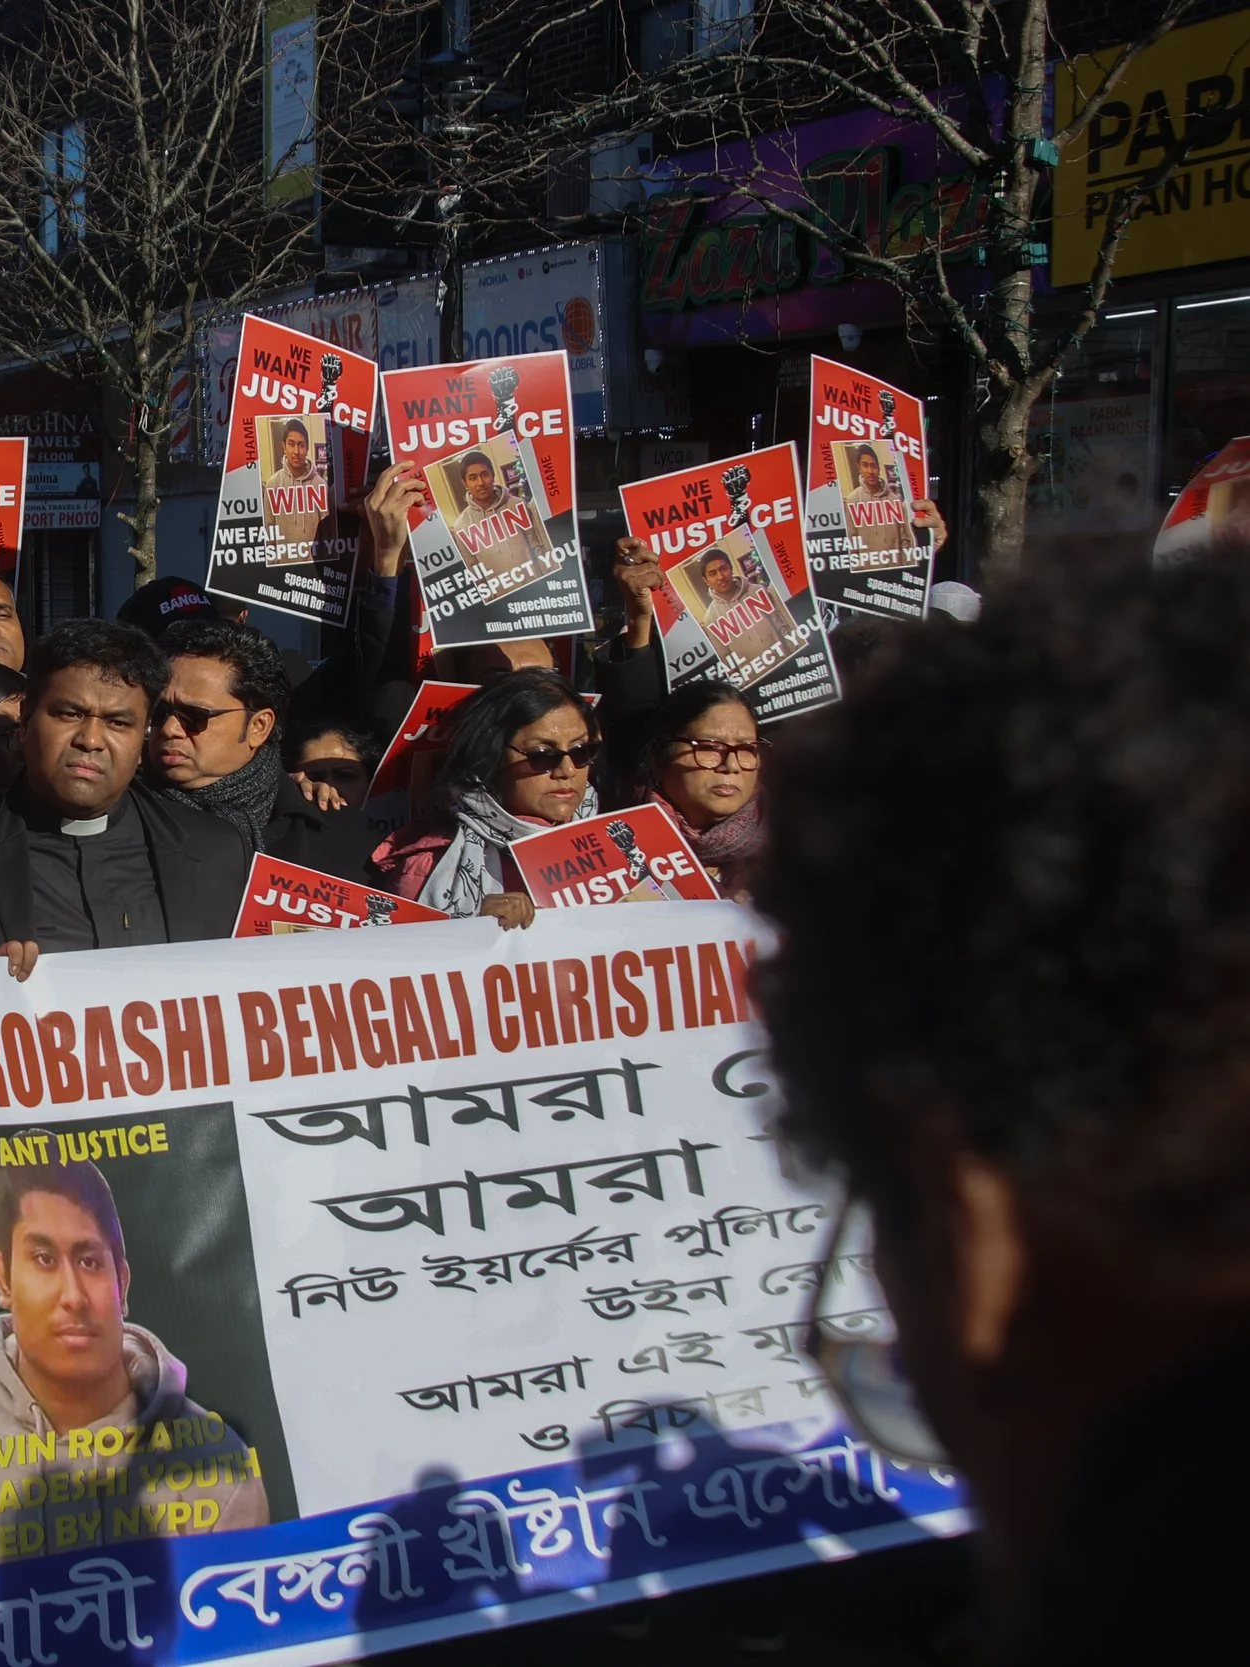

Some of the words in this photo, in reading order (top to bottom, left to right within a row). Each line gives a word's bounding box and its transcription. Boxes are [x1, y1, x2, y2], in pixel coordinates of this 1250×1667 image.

[643, 193, 799, 308] Zaza
[479, 273, 508, 288] NOKIA
[312, 313, 363, 350] HAIR
[253, 349, 310, 383] WANT
[290, 344, 311, 365] WE
[571, 357, 597, 370] LOBAL
[446, 376, 476, 393] WE
[824, 384, 871, 414] WANT
[852, 380, 871, 398] WE
[403, 394, 477, 420] WANT
[29, 436, 81, 447] RAVELS
[38, 452, 75, 461] FLOOR
[246, 417, 256, 469] SHAME
[541, 455, 560, 497] SHAME
[820, 442, 837, 487] SHAME
[266, 484, 328, 516] WIN
[681, 480, 710, 499] WE
[59, 511, 99, 525] PHOTO
[222, 499, 258, 515] YOU
[643, 495, 713, 529] WANT
[808, 512, 840, 528] YOU
[848, 500, 905, 527] WIN
[219, 528, 246, 545] WE
[248, 525, 285, 543] FAIL
[456, 502, 532, 555] WIN
[806, 539, 832, 553] WE
[834, 536, 867, 551] FAIL
[214, 549, 237, 565] TO
[243, 541, 319, 563] RESPECT
[417, 546, 455, 571] YOU
[773, 540, 796, 579] SHAME
[830, 549, 898, 570] RESPECT
[903, 545, 931, 560] YOU
[425, 577, 457, 601] WE
[455, 562, 494, 592] FAIL
[430, 600, 455, 623] TO
[459, 561, 534, 611] RESPECT
[538, 539, 579, 565] YOU
[508, 593, 581, 614] speechless!!!
[708, 588, 775, 647] WIN
[523, 614, 544, 629] WIN
[545, 611, 584, 627] Rozario
[785, 613, 824, 647] YOU
[668, 642, 708, 676] YOU
[705, 651, 748, 682] FAIL
[759, 666, 829, 697] speechless!!!
[571, 833, 601, 852] WE
[540, 850, 607, 885] WANT
[270, 874, 350, 907] WANT
[320, 880, 350, 899] WE
[238, 971, 477, 1083] BENGALI
[482, 940, 758, 1053] CHRISTIAN
[247, 1058, 662, 1150] আমরা
[58, 1122, 169, 1167] JUSTICE
[310, 1139, 721, 1235] আমরা
[278, 1266, 405, 1318] নিউ
[582, 1276, 733, 1320] উইন
[396, 1356, 594, 1413] আমরা
[618, 1332, 726, 1376] এই
[68, 1411, 226, 1458] ROZARIO
[140, 1447, 262, 1492] YOUTH
[56, 1510, 102, 1547] BY
[113, 1499, 220, 1536] NYPD
